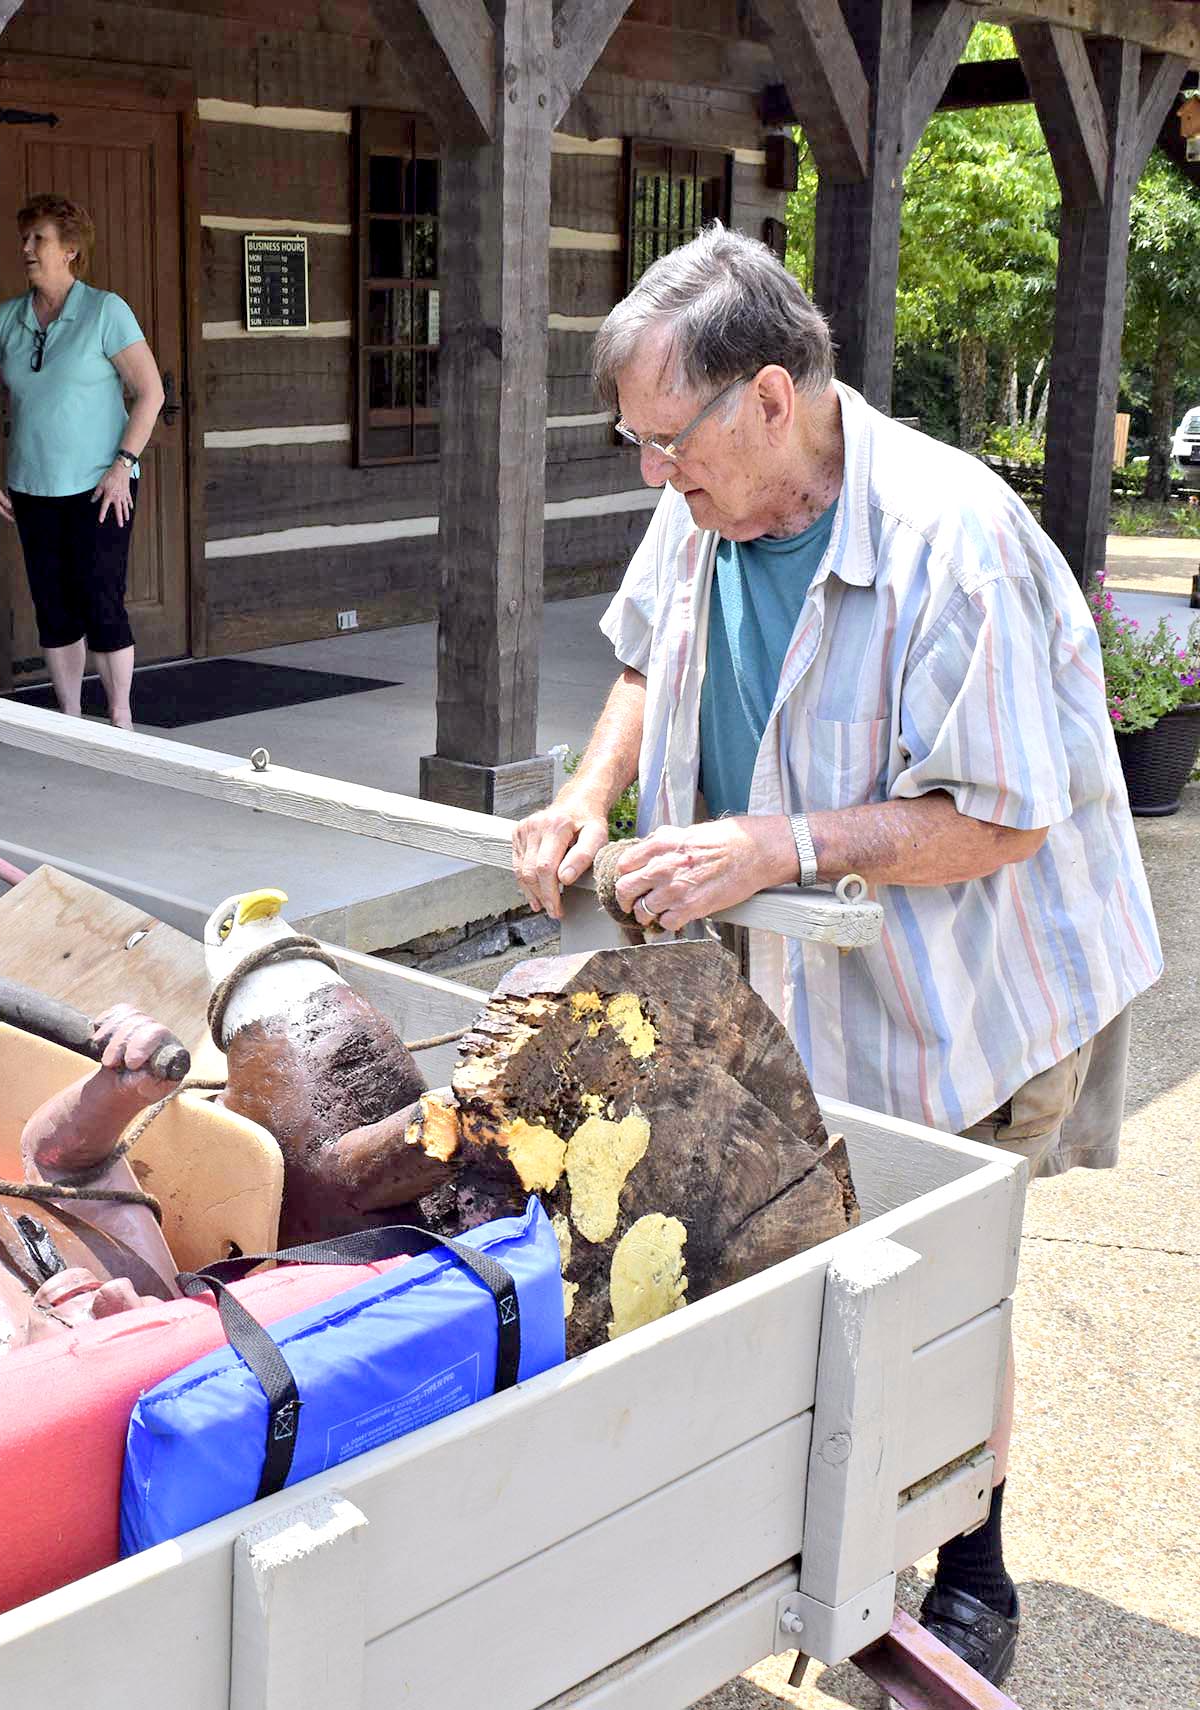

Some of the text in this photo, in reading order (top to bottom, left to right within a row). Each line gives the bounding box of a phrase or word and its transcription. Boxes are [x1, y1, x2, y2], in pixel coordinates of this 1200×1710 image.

[248, 241, 305, 252] BUSINESS HOURS
[248, 254, 262, 262] MON
